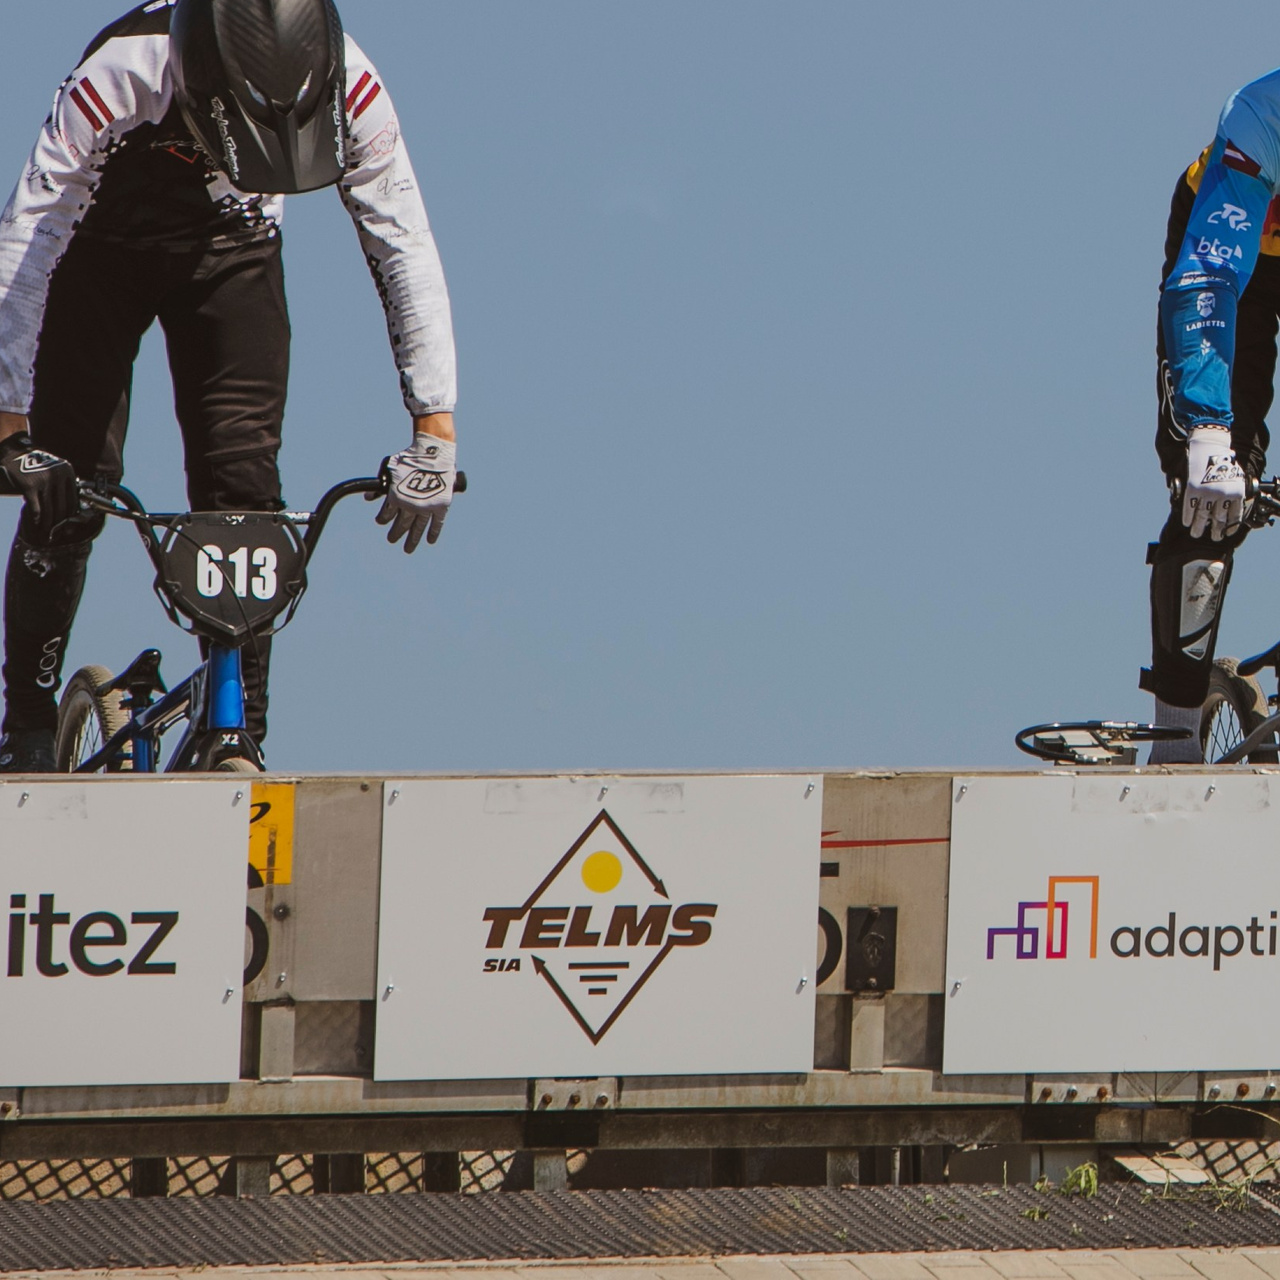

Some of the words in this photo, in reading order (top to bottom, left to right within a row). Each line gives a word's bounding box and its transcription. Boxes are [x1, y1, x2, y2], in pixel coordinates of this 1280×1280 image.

[1197, 236, 1233, 260] bta
[1186, 320, 1225, 332] LABIETIS
[196, 544, 278, 600] 613
[221, 733, 239, 746] X2
[7, 893, 180, 978] itez
[482, 902, 718, 950] TELMS
[482, 957, 522, 973] SIA
